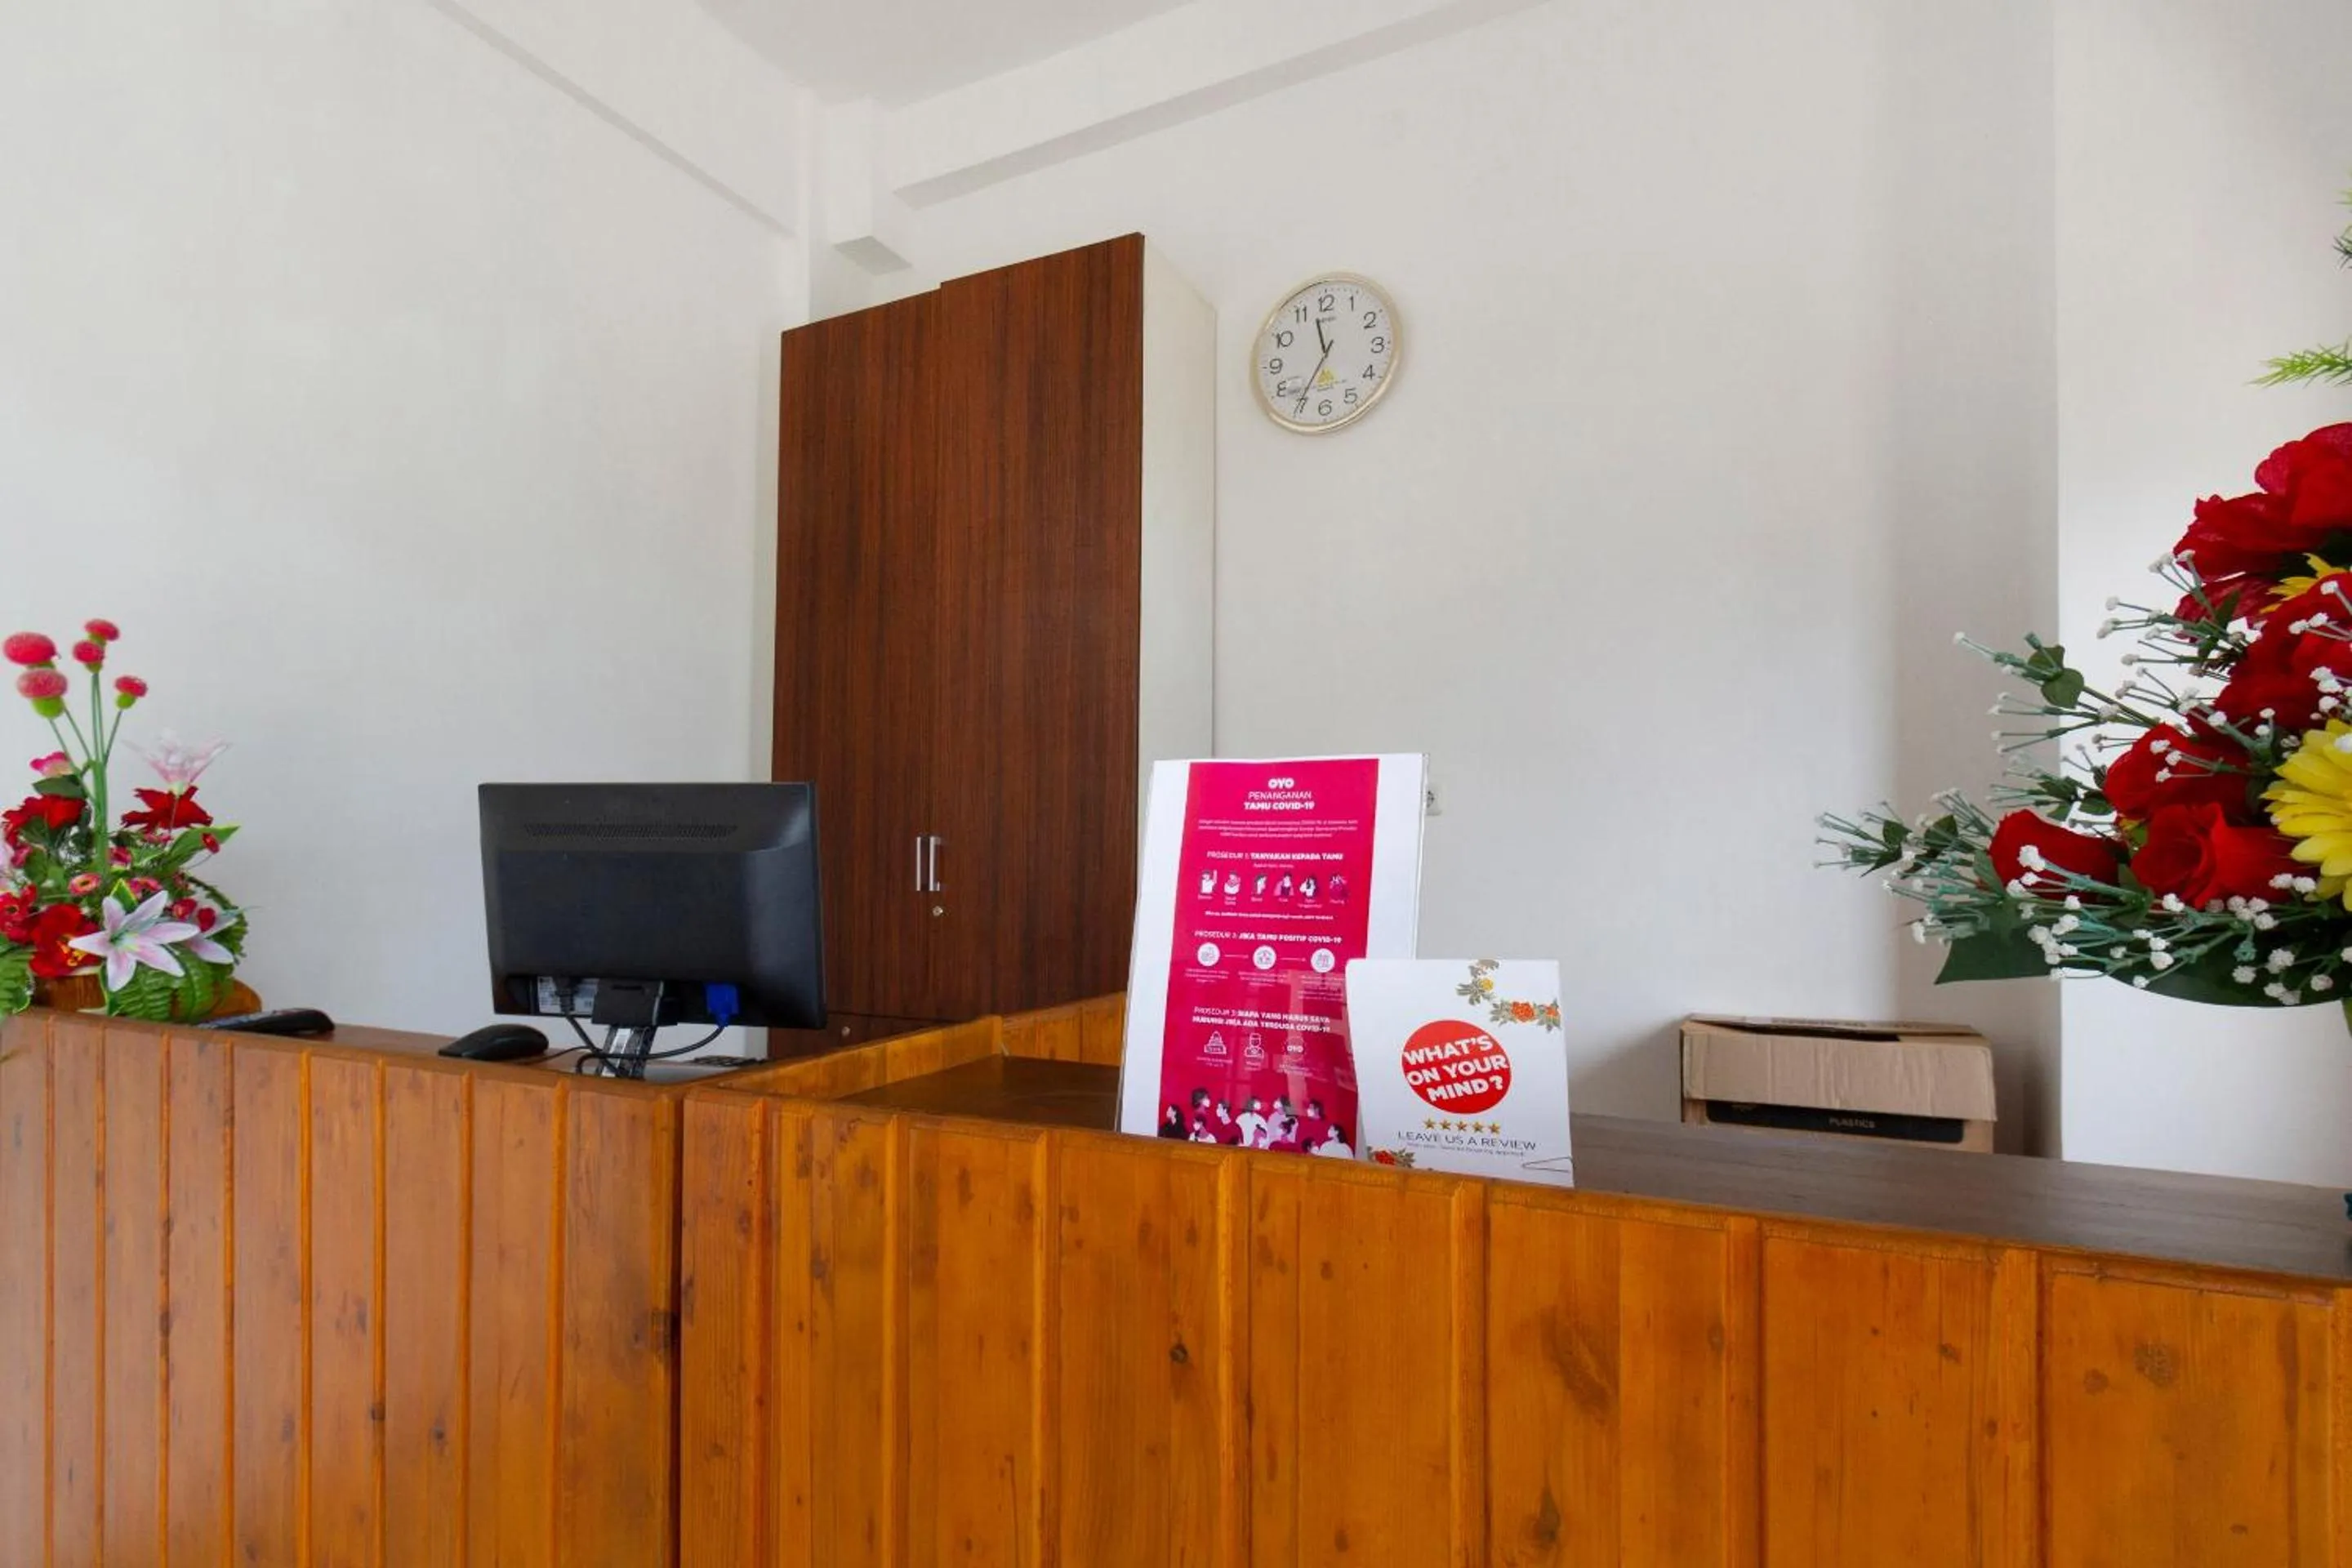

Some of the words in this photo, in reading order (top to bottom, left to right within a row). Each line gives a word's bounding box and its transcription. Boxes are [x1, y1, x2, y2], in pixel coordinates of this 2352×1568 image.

[1318, 294, 1335, 312] 12
[1349, 295, 1354, 312] 1
[1294, 305, 1307, 323] 11
[1363, 311, 1377, 329] 2
[1276, 330, 1294, 349] 10
[1370, 336, 1385, 354] 3
[1269, 358, 1283, 375] 9
[1362, 364, 1375, 380] 4
[1343, 388, 1358, 404] 5
[1318, 399, 1333, 416] 6
[1268, 777, 1295, 789] OYO
[1248, 791, 1312, 800] PENANGANAN
[1244, 801, 1271, 810] TAMU
[1272, 801, 1315, 810] COVID-19
[1206, 850, 1244, 859] PROSEDUR
[1250, 852, 1291, 860] TANYAKAN
[1321, 853, 1343, 861] TAMU
[1239, 932, 1255, 940] JIKA
[1257, 933, 1277, 941] TAMU
[1279, 933, 1307, 942] POSITIF
[1307, 935, 1343, 944] COVID-19
[1242, 1019, 1258, 1027] ADA
[1404, 1035, 1494, 1066] WHAT'S
[1406, 1067, 1441, 1085] ON
[1441, 1054, 1509, 1079] YOUR
[1829, 1116, 1876, 1129] PLASTICS
[1398, 1130, 1439, 1143] LEAVE
[1445, 1135, 1463, 1144] US
[1468, 1136, 1477, 1145] A
[1481, 1138, 1537, 1151] REVIEW
